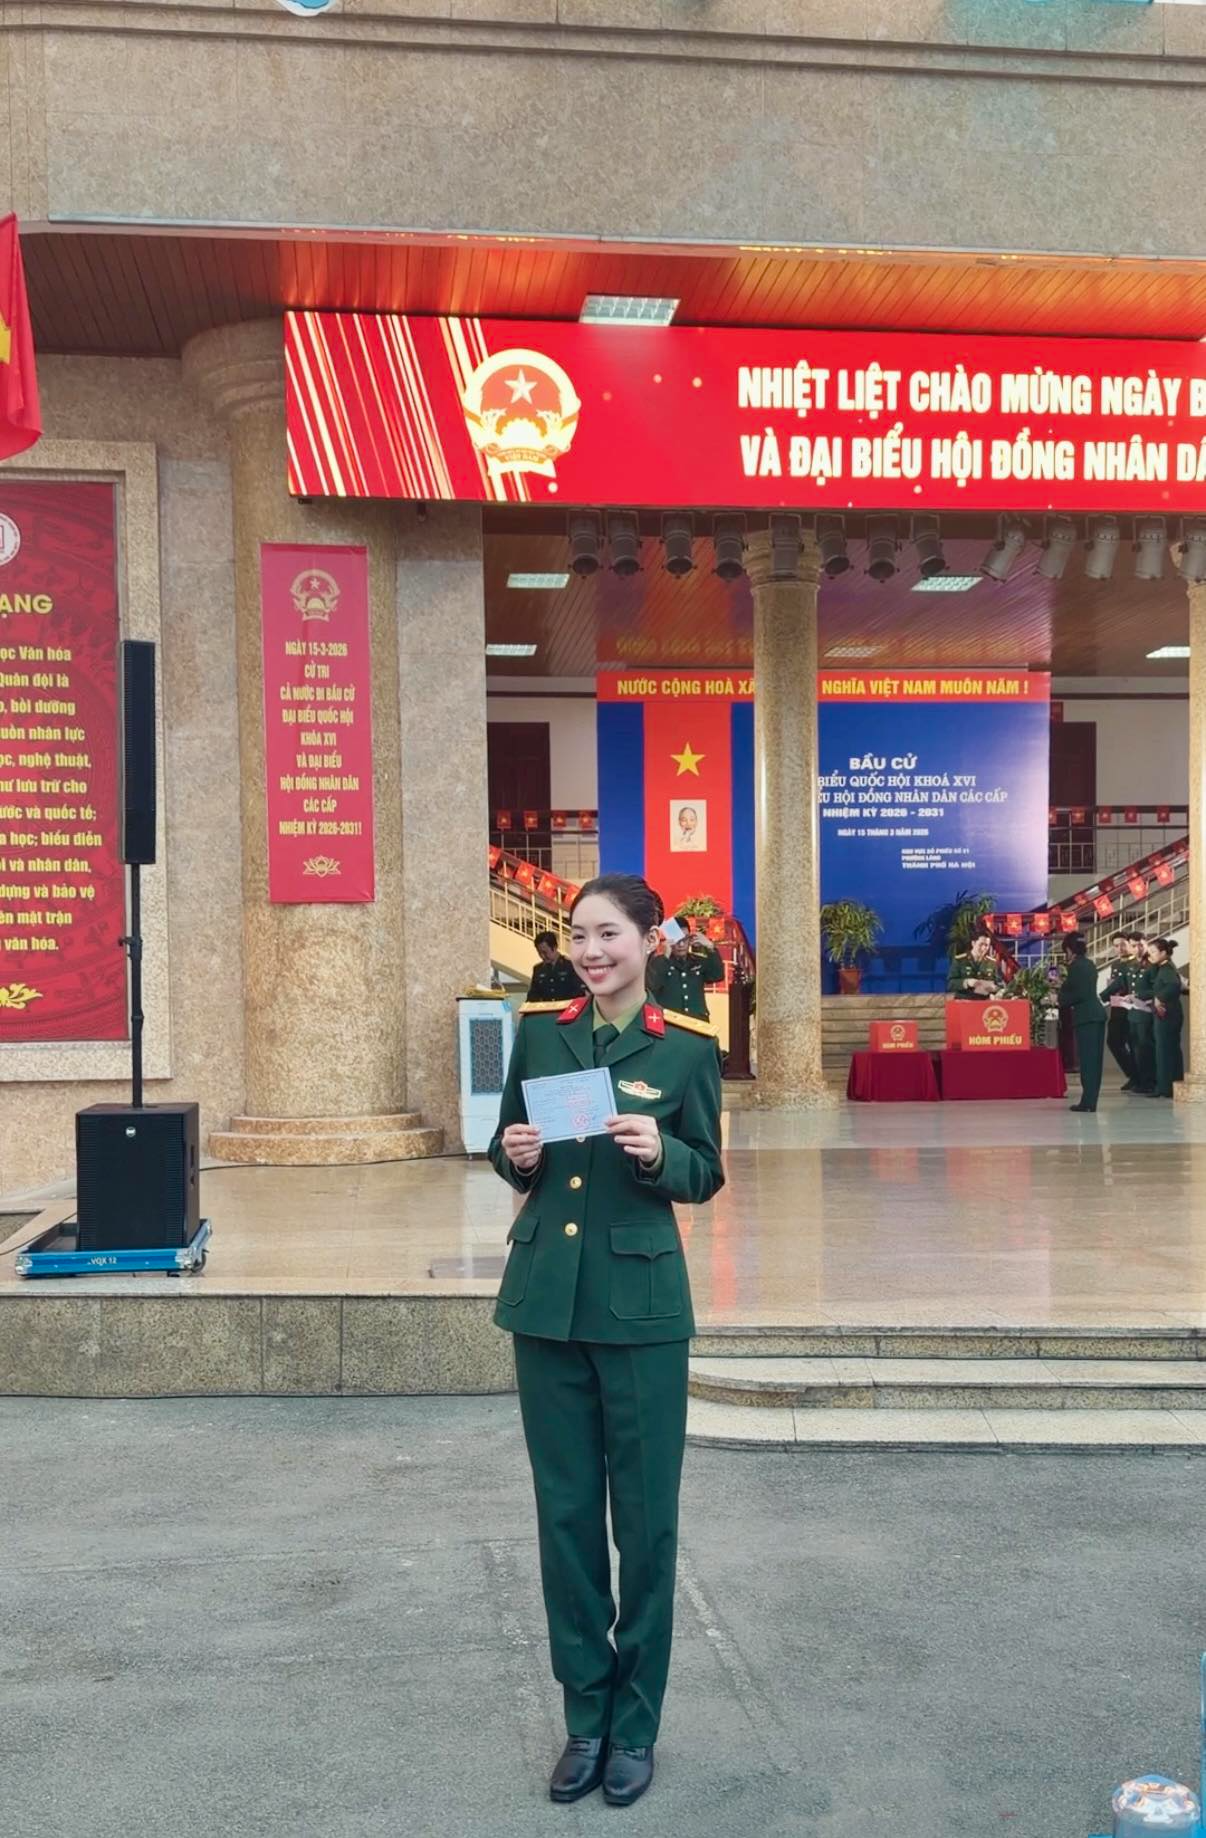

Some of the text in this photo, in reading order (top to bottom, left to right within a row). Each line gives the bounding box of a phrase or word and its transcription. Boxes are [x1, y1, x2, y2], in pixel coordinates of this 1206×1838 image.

[738, 360, 830, 418] NHIỆT
[837, 362, 901, 419] LIỆT
[909, 364, 992, 413] CHÀO
[1001, 366, 1092, 415] MỪNG
[1101, 369, 1182, 416] NGÀY
[740, 427, 782, 477] VÀ
[789, 436, 842, 486] ĐẠI
[851, 422, 922, 479] BIỂU
[931, 431, 982, 487] HỘI
[991, 427, 1075, 480] ĐỒNG
[1084, 434, 1168, 481] NHÂN
[18, 645, 43, 660] Văn
[47, 646, 72, 661] hóa
[285, 638, 306, 655] NGÀY
[317, 664, 330, 678] TRI
[32, 673, 54, 689] đội
[56, 673, 70, 688] là
[617, 678, 657, 695] NƯỚC
[661, 678, 700, 697] CỘNG
[705, 677, 735, 695] HOÀ
[822, 677, 865, 695] NGHĨA
[870, 677, 900, 698] VIỆT
[903, 680, 936, 695] NAM
[940, 678, 982, 695] MUÔN
[986, 678, 1020, 695] NĂM
[29, 726, 62, 740] nhân
[64, 726, 85, 743] lực
[18, 752, 51, 769] nghệ
[849, 752, 918, 770] BẦU CỬ
[16, 778, 37, 792] lưu
[41, 778, 61, 793] trữ
[63, 779, 87, 793] cho
[850, 771, 885, 787] QUỐC
[888, 772, 911, 788] HỘI
[914, 772, 950, 787] KHOÁ
[953, 775, 976, 787] XVI
[833, 789, 856, 805] HỘI
[859, 787, 892, 803] ĐỒNG
[895, 789, 929, 803] NHÂN
[932, 789, 958, 803] DÂN
[959, 789, 983, 803] CÁC
[985, 786, 1009, 803] CẤP
[25, 805, 41, 819] và
[44, 803, 77, 821] quốc
[823, 806, 860, 819] NHIỆM
[863, 806, 877, 818] KỲ
[918, 807, 944, 817] 2031
[10, 831, 38, 848] học;
[41, 829, 70, 846] biểu
[73, 830, 102, 846] diễn
[9, 858, 24, 872] và
[28, 857, 61, 872] nhân
[33, 884, 49, 898] và
[52, 882, 77, 898] bảo
[79, 883, 95, 901] vệ
[46, 910, 72, 927] trận
[4, 936, 28, 950] văn
[993, 1033, 1023, 1046] PHIẾU
